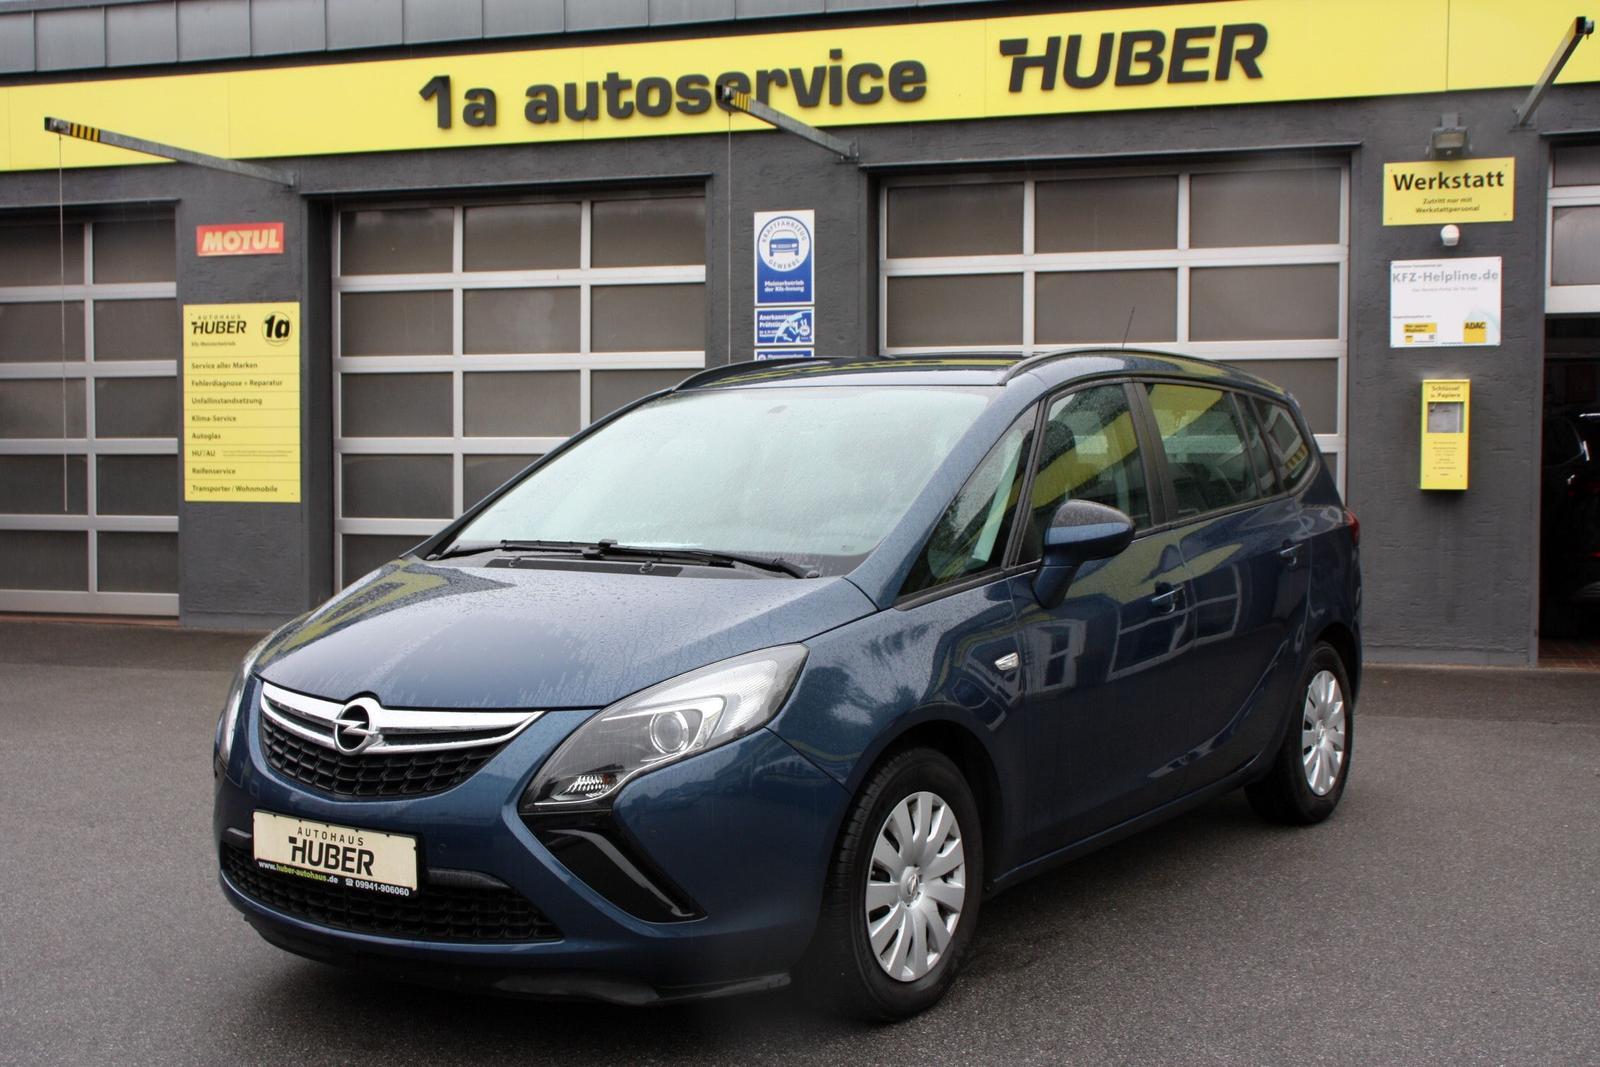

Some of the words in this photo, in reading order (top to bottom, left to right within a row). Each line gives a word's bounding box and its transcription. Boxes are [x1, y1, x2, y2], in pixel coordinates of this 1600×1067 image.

[999, 22, 1269, 93] HUBER
[418, 74, 497, 130] 1a
[523, 48, 929, 124] autoservice
[1393, 171, 1504, 191] Werkstatt
[1415, 204, 1480, 214] Werkstattpersonal
[761, 220, 808, 243] KRAFTFAHRZEUG
[201, 228, 281, 253] MOTUL
[768, 257, 801, 270] GEWERBE
[1392, 269, 1499, 284] KFZ-Helpline.de
[191, 320, 247, 335] HUBER
[263, 314, 291, 339] 1a
[1465, 322, 1487, 330] ADAC
[216, 361, 231, 369] aller
[232, 361, 258, 369] Marken
[191, 380, 243, 388] Fehlerdiagnose
[249, 379, 284, 387] Reparatur
[191, 397, 263, 406] Unfallinstandsetzung
[191, 432, 222, 441] Autoglas
[191, 467, 236, 475] Reifenservice
[192, 484, 231, 493] Transporter
[235, 484, 278, 492] Wohnmobile
[297, 826, 364, 847] AUTOHAUS
[288, 836, 375, 877] HUBER
[258, 861, 339, 884] www.huber-autohaus.de
[355, 880, 410, 897] 09941-906060
